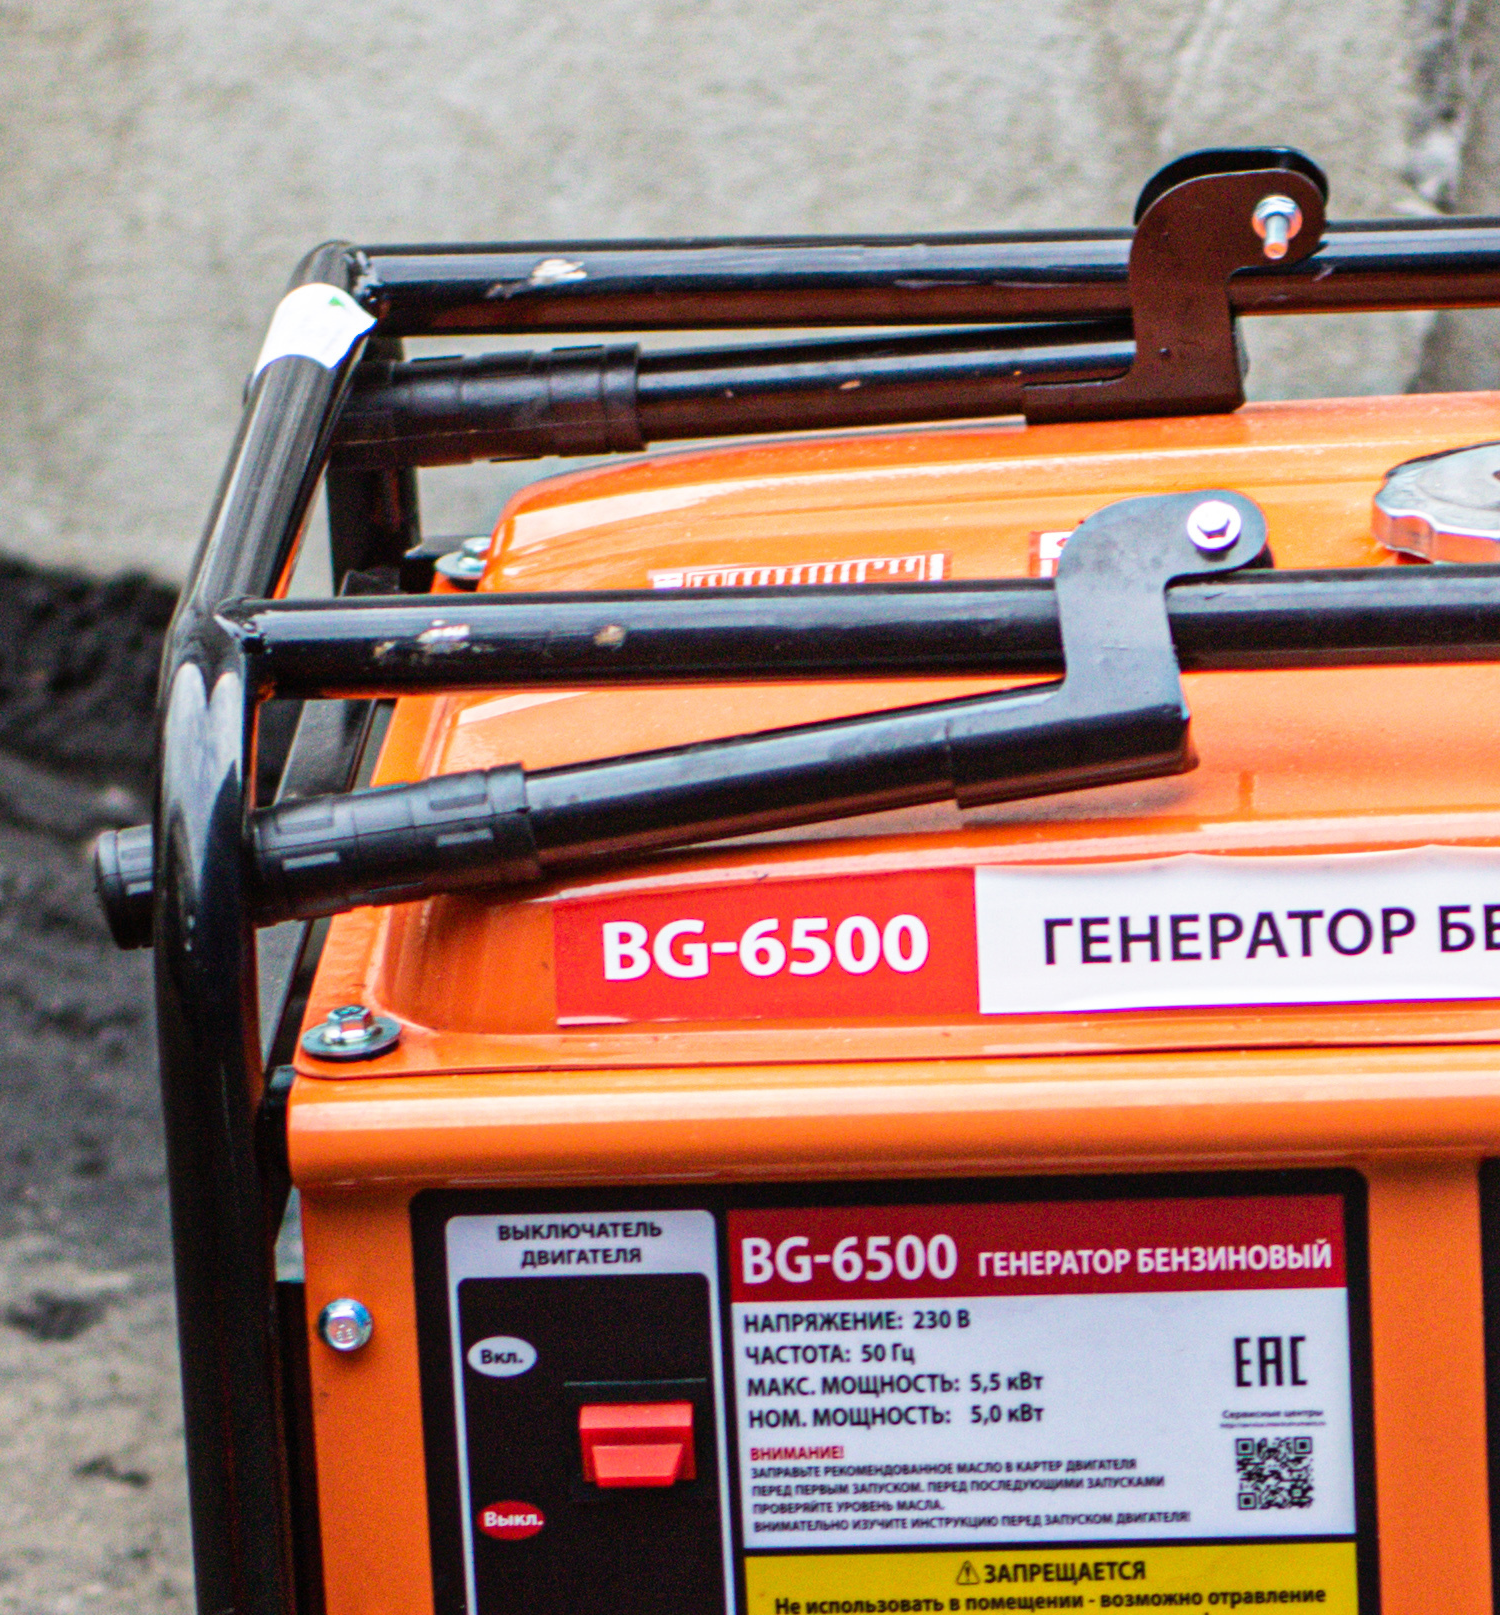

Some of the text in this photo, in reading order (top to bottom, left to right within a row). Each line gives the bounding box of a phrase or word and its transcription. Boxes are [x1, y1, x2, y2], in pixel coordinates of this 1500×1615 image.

[603, 914, 928, 980] BG-6500
[1045, 907, 1415, 965] ГЕНЕРАТОР
[498, 1221, 662, 1242] ВЫКЛЮЧАТЕЛЬ
[521, 1248, 641, 1269] ДВИГАТЕЛЯ
[742, 1233, 957, 1283] BG-6500
[979, 1239, 1331, 1276] ГЕНЕРАТОР БЕНЗИНОВЫЙ
[744, 1309, 970, 1333] НАПРЯЖЕНИЕ: 230 В
[481, 1349, 522, 1365] Вкл.
[746, 1343, 915, 1365] ЧАСТОТА: 50 Гц
[748, 1371, 1043, 1397] МАКС. МОЩНОСТЬ: 5,5 кВт
[749, 1403, 1043, 1430] НОМ. МОЩНОСТЬ: 5,0 кВт
[750, 1445, 843, 1461] ВНИМАНИЕ!
[752, 1459, 1136, 1479] ЗАПРАВЬТЕ РЕКОМЕНДОВАННОЕ МАСЛО В КАРТЕР ДВИГАТЕЛЯ
[752, 1484, 792, 1498] ПЕРЕД
[795, 1484, 849, 1496] ПЕРВЫМ
[928, 1481, 968, 1493] ПЕРЕД
[970, 1478, 1083, 1492] ПОСЛЕДУЮЩИМИ
[1088, 1476, 1164, 1489] ЗАПУСКАМИ
[753, 1501, 832, 1514] ПРОВЕРЯЙТЕ
[837, 1501, 893, 1513] УРОВЕНЬ
[484, 1511, 543, 1527] Выкл.
[754, 1519, 849, 1533] ВНИМАТЕЛЬНО
[852, 1517, 907, 1530] ИЗУЧИТЕ
[911, 1515, 999, 1529] ИНСТРУКЦИЮ
[1001, 1514, 1042, 1527] ПЕРЕД
[1045, 1513, 1113, 1526] ЗАПУСКОМ
[985, 1560, 1145, 1586] ЗАПРЕЩАЕТСЯ
[775, 1597, 801, 1615] Не
[806, 1598, 944, 1615] использовать
[949, 1598, 960, 1612] в
[965, 1595, 1083, 1612] помещении
[1100, 1592, 1203, 1608] возможно
[1206, 1589, 1327, 1608] отравление
